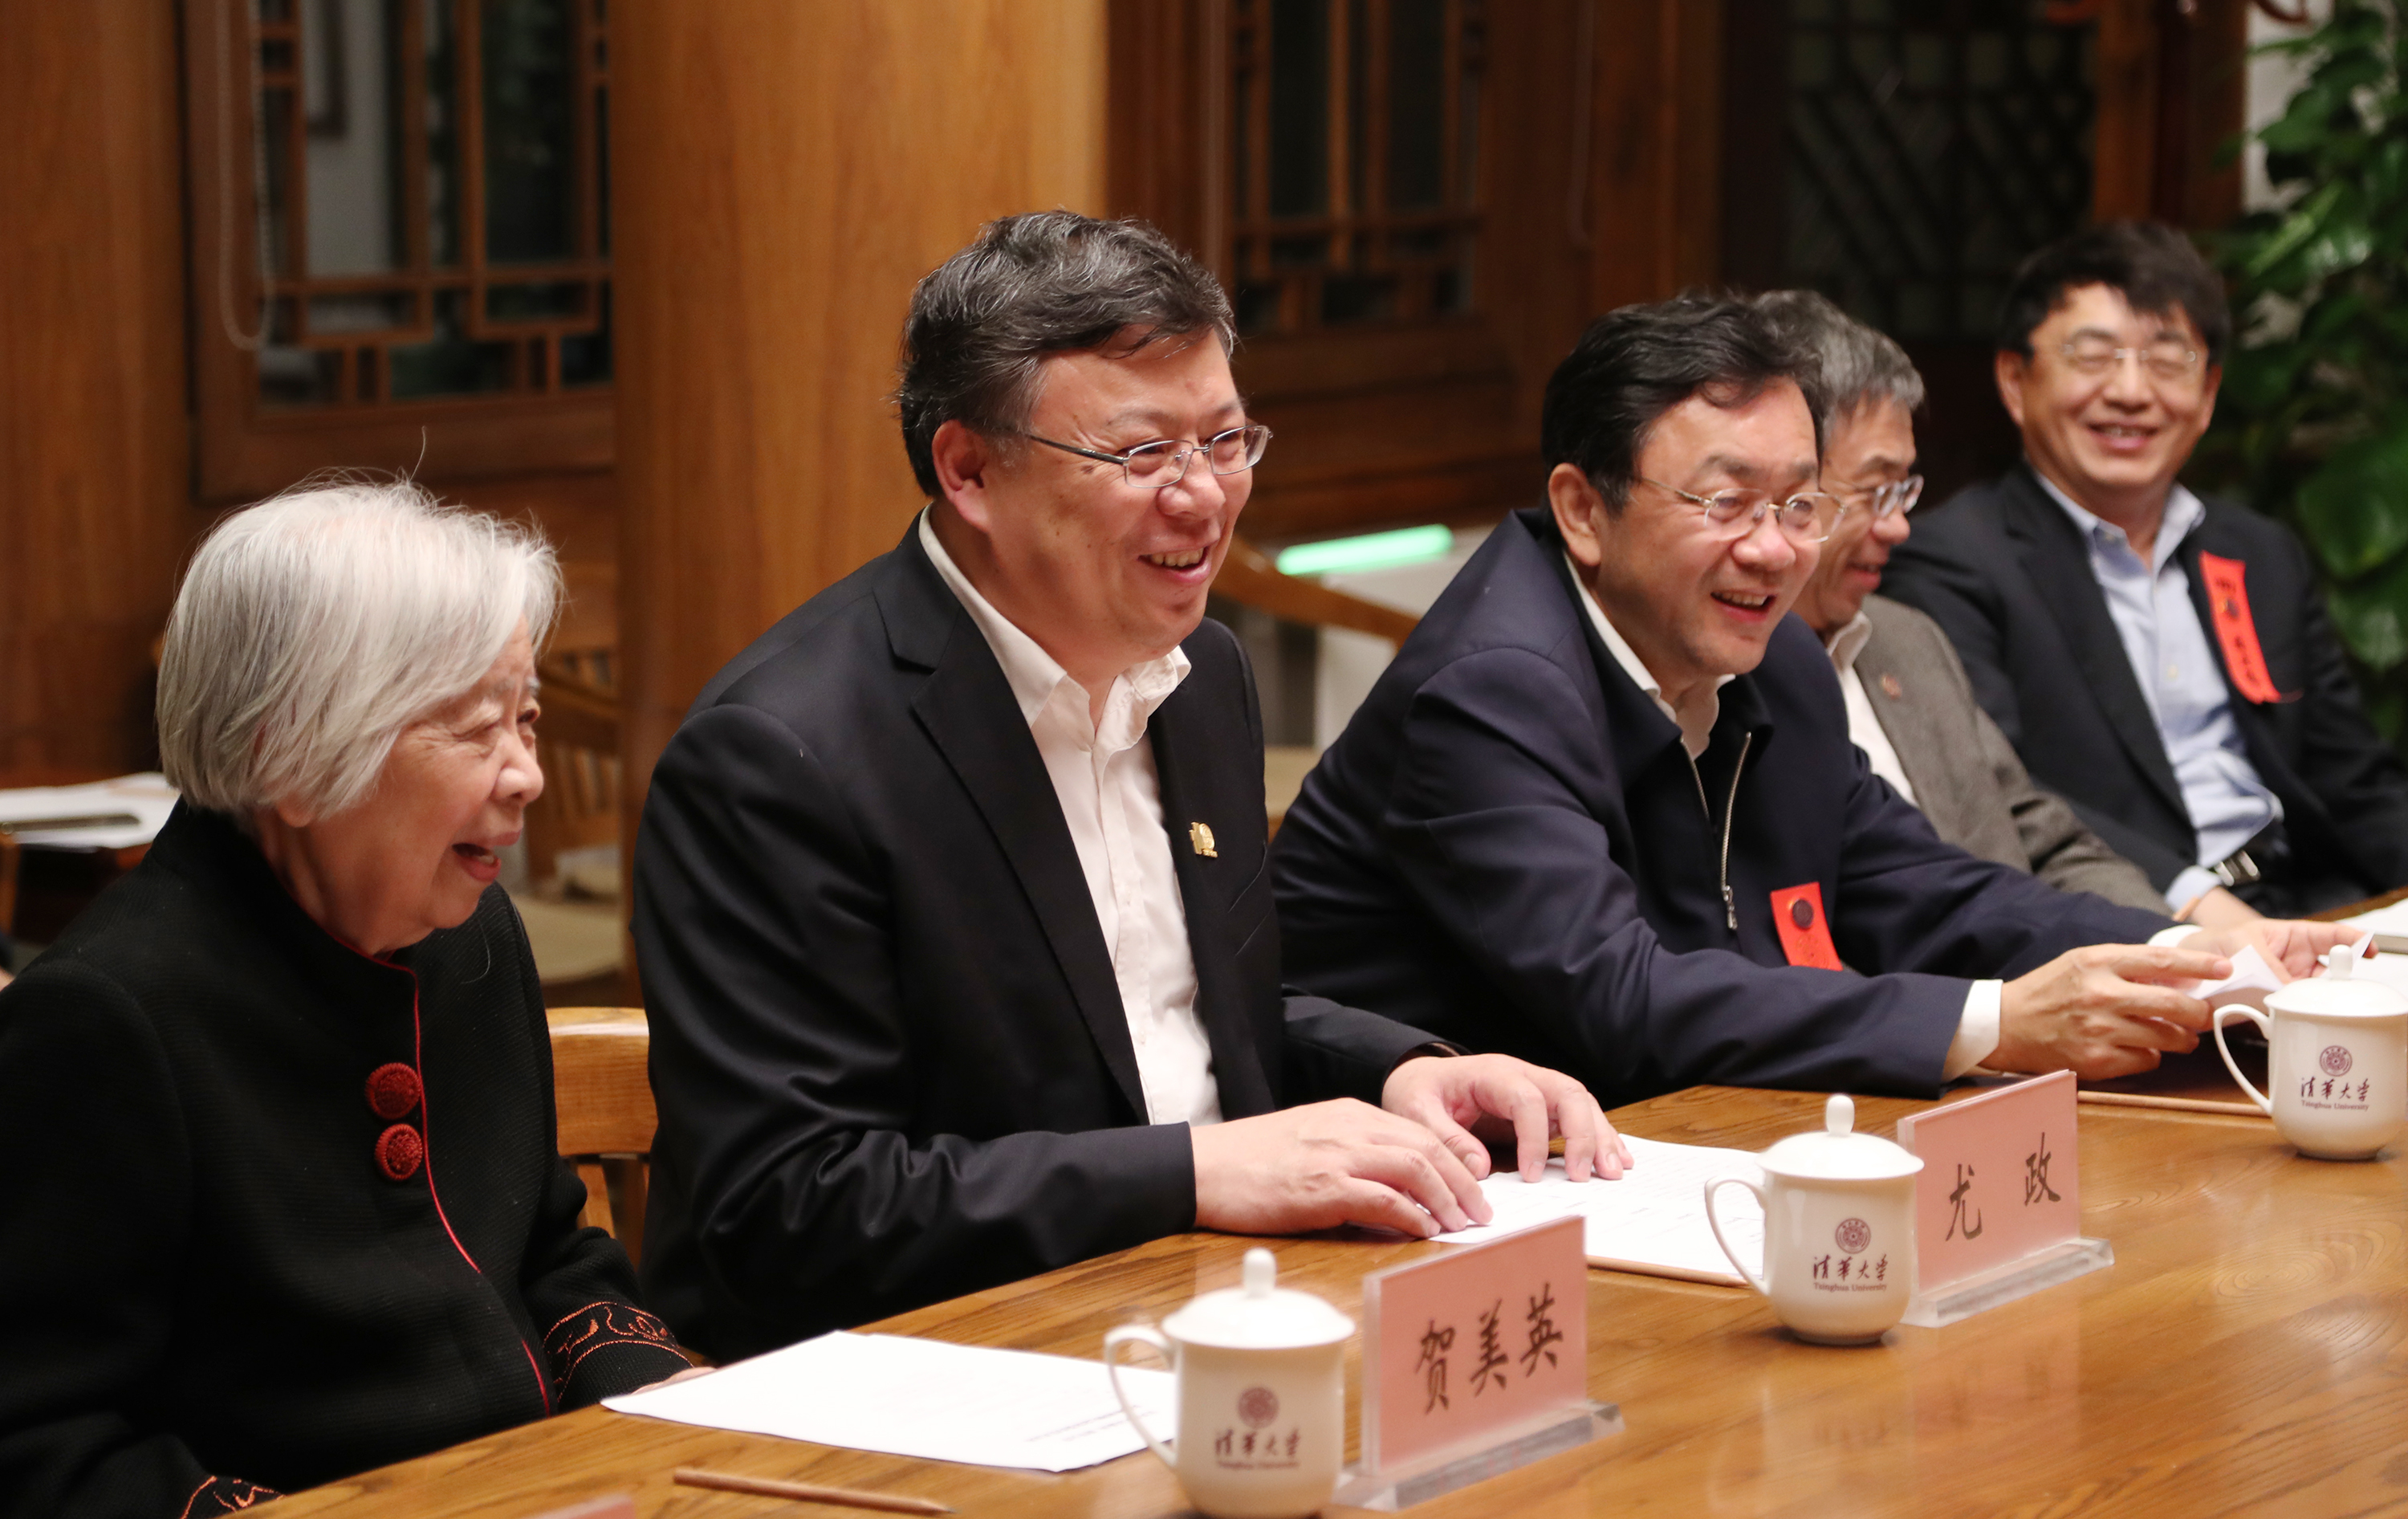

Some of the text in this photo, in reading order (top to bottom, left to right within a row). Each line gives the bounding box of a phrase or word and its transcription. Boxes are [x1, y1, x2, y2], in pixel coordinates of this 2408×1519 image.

[1945, 1132, 2061, 1242] 尤政
[1813, 1282, 1888, 1292] Tsinghua University
[1415, 1281, 1564, 1415] 贺美英
